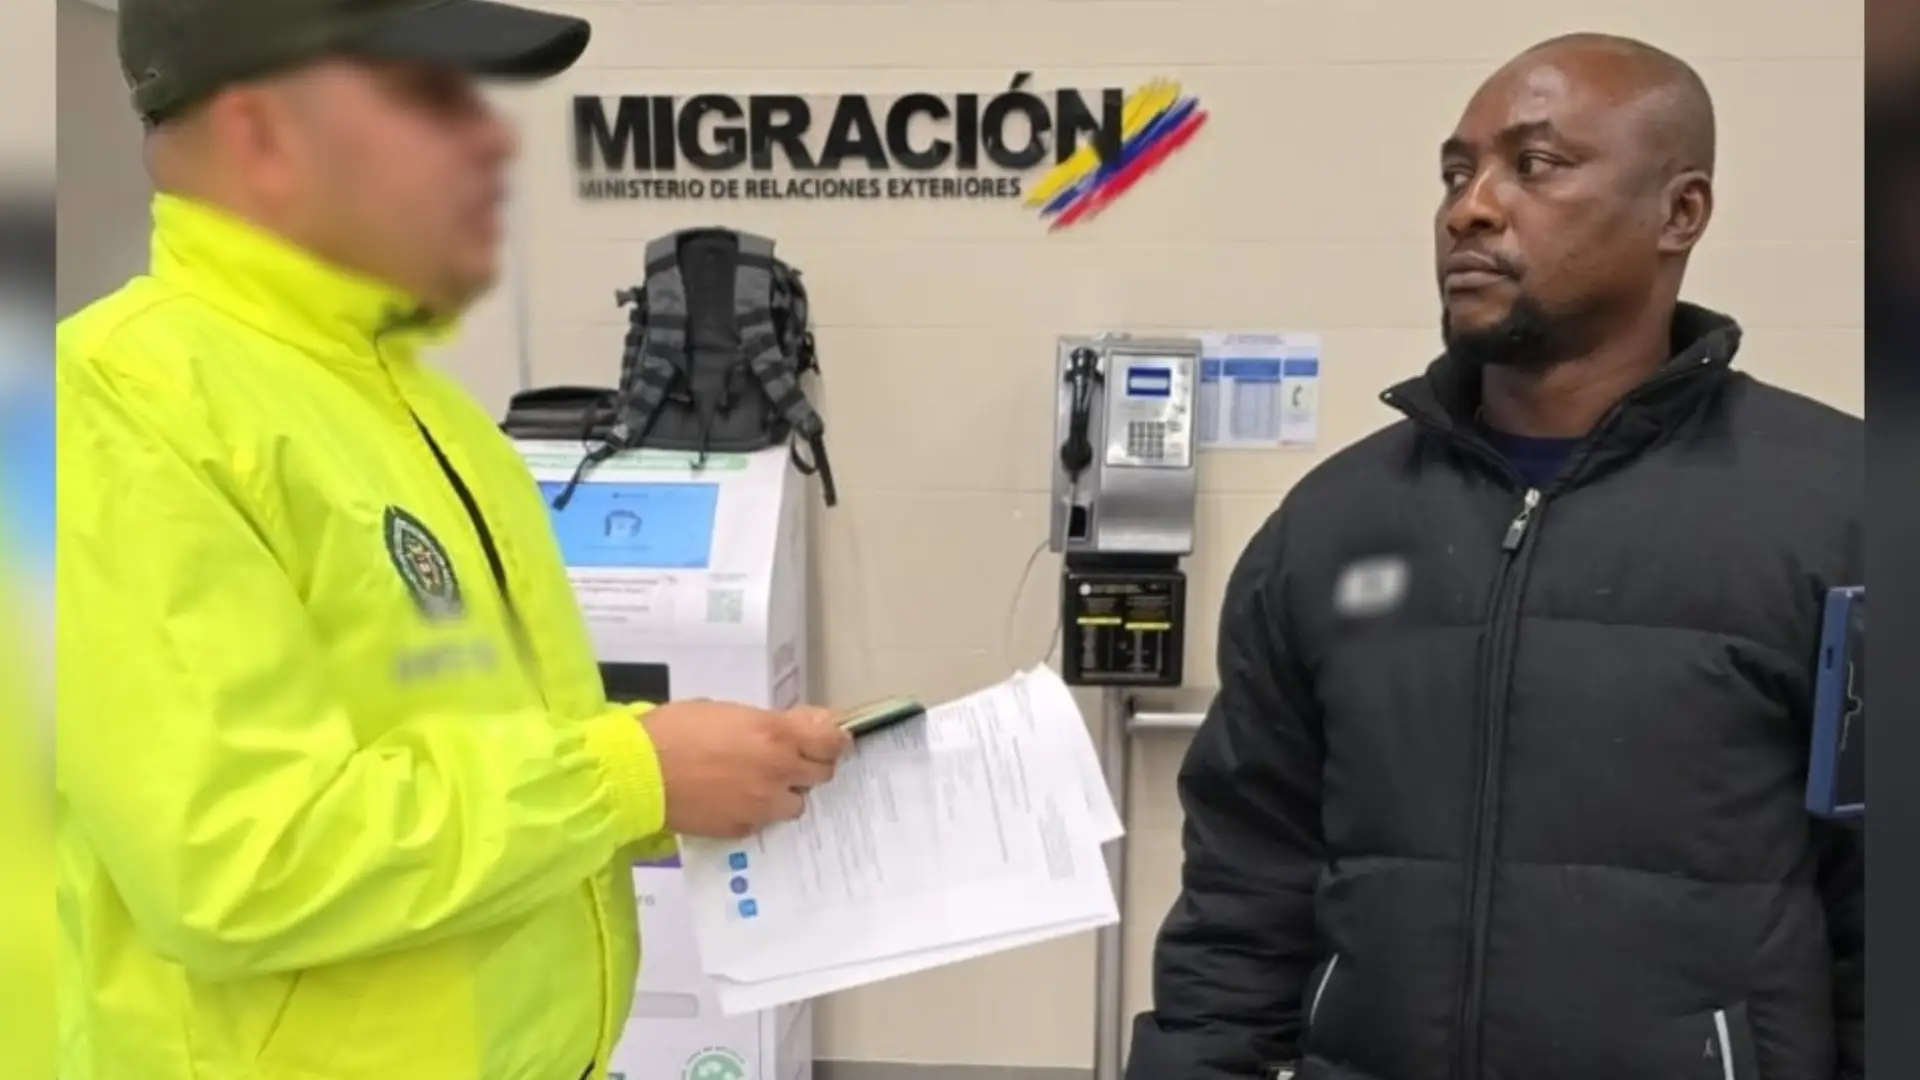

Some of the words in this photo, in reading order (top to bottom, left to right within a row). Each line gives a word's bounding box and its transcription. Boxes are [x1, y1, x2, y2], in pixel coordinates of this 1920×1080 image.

[574, 71, 1123, 171] MIGRACIÓN
[579, 178, 704, 199] MINISTERIO
[711, 178, 739, 199] DE
[745, 177, 880, 199] RELACIONES
[888, 177, 1021, 199] EXTERIORES
